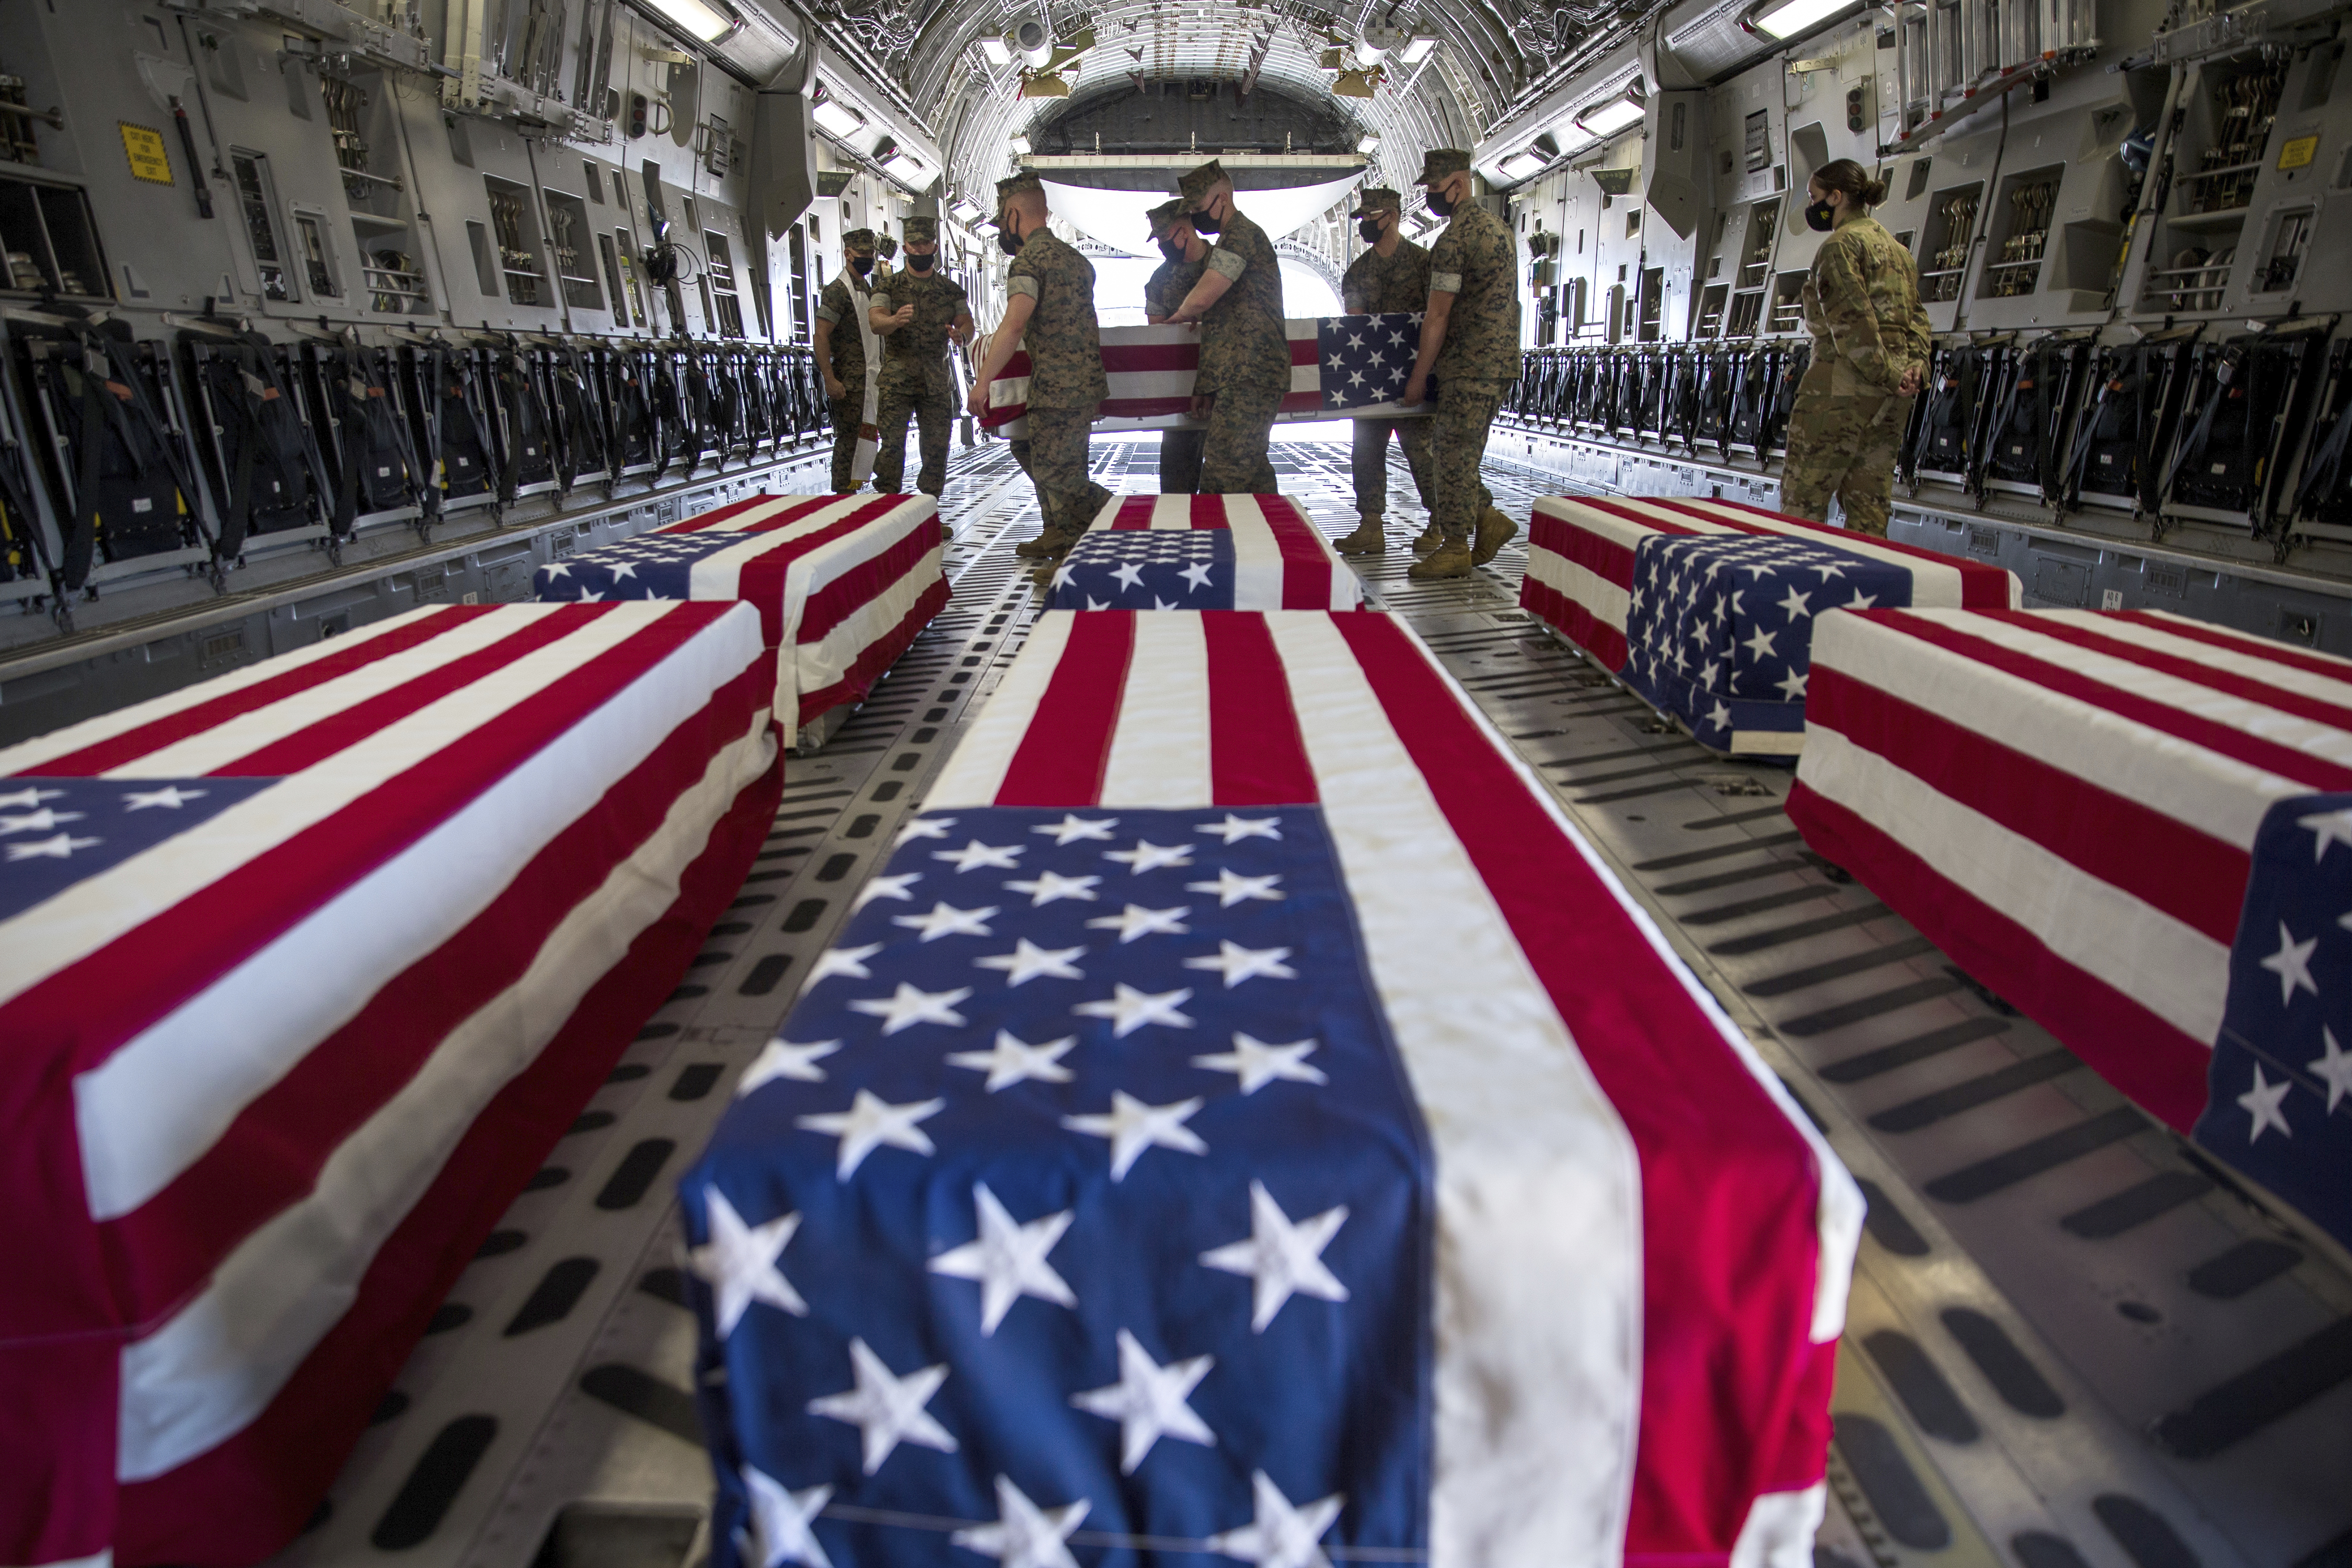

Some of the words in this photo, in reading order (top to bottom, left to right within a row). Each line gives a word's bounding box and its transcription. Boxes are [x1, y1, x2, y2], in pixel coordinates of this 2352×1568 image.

[134, 153, 163, 166] EMERGENCY
[146, 166, 157, 175] EXIT
[2107, 591, 2114, 601] AD
[2115, 593, 2118, 602] 6
